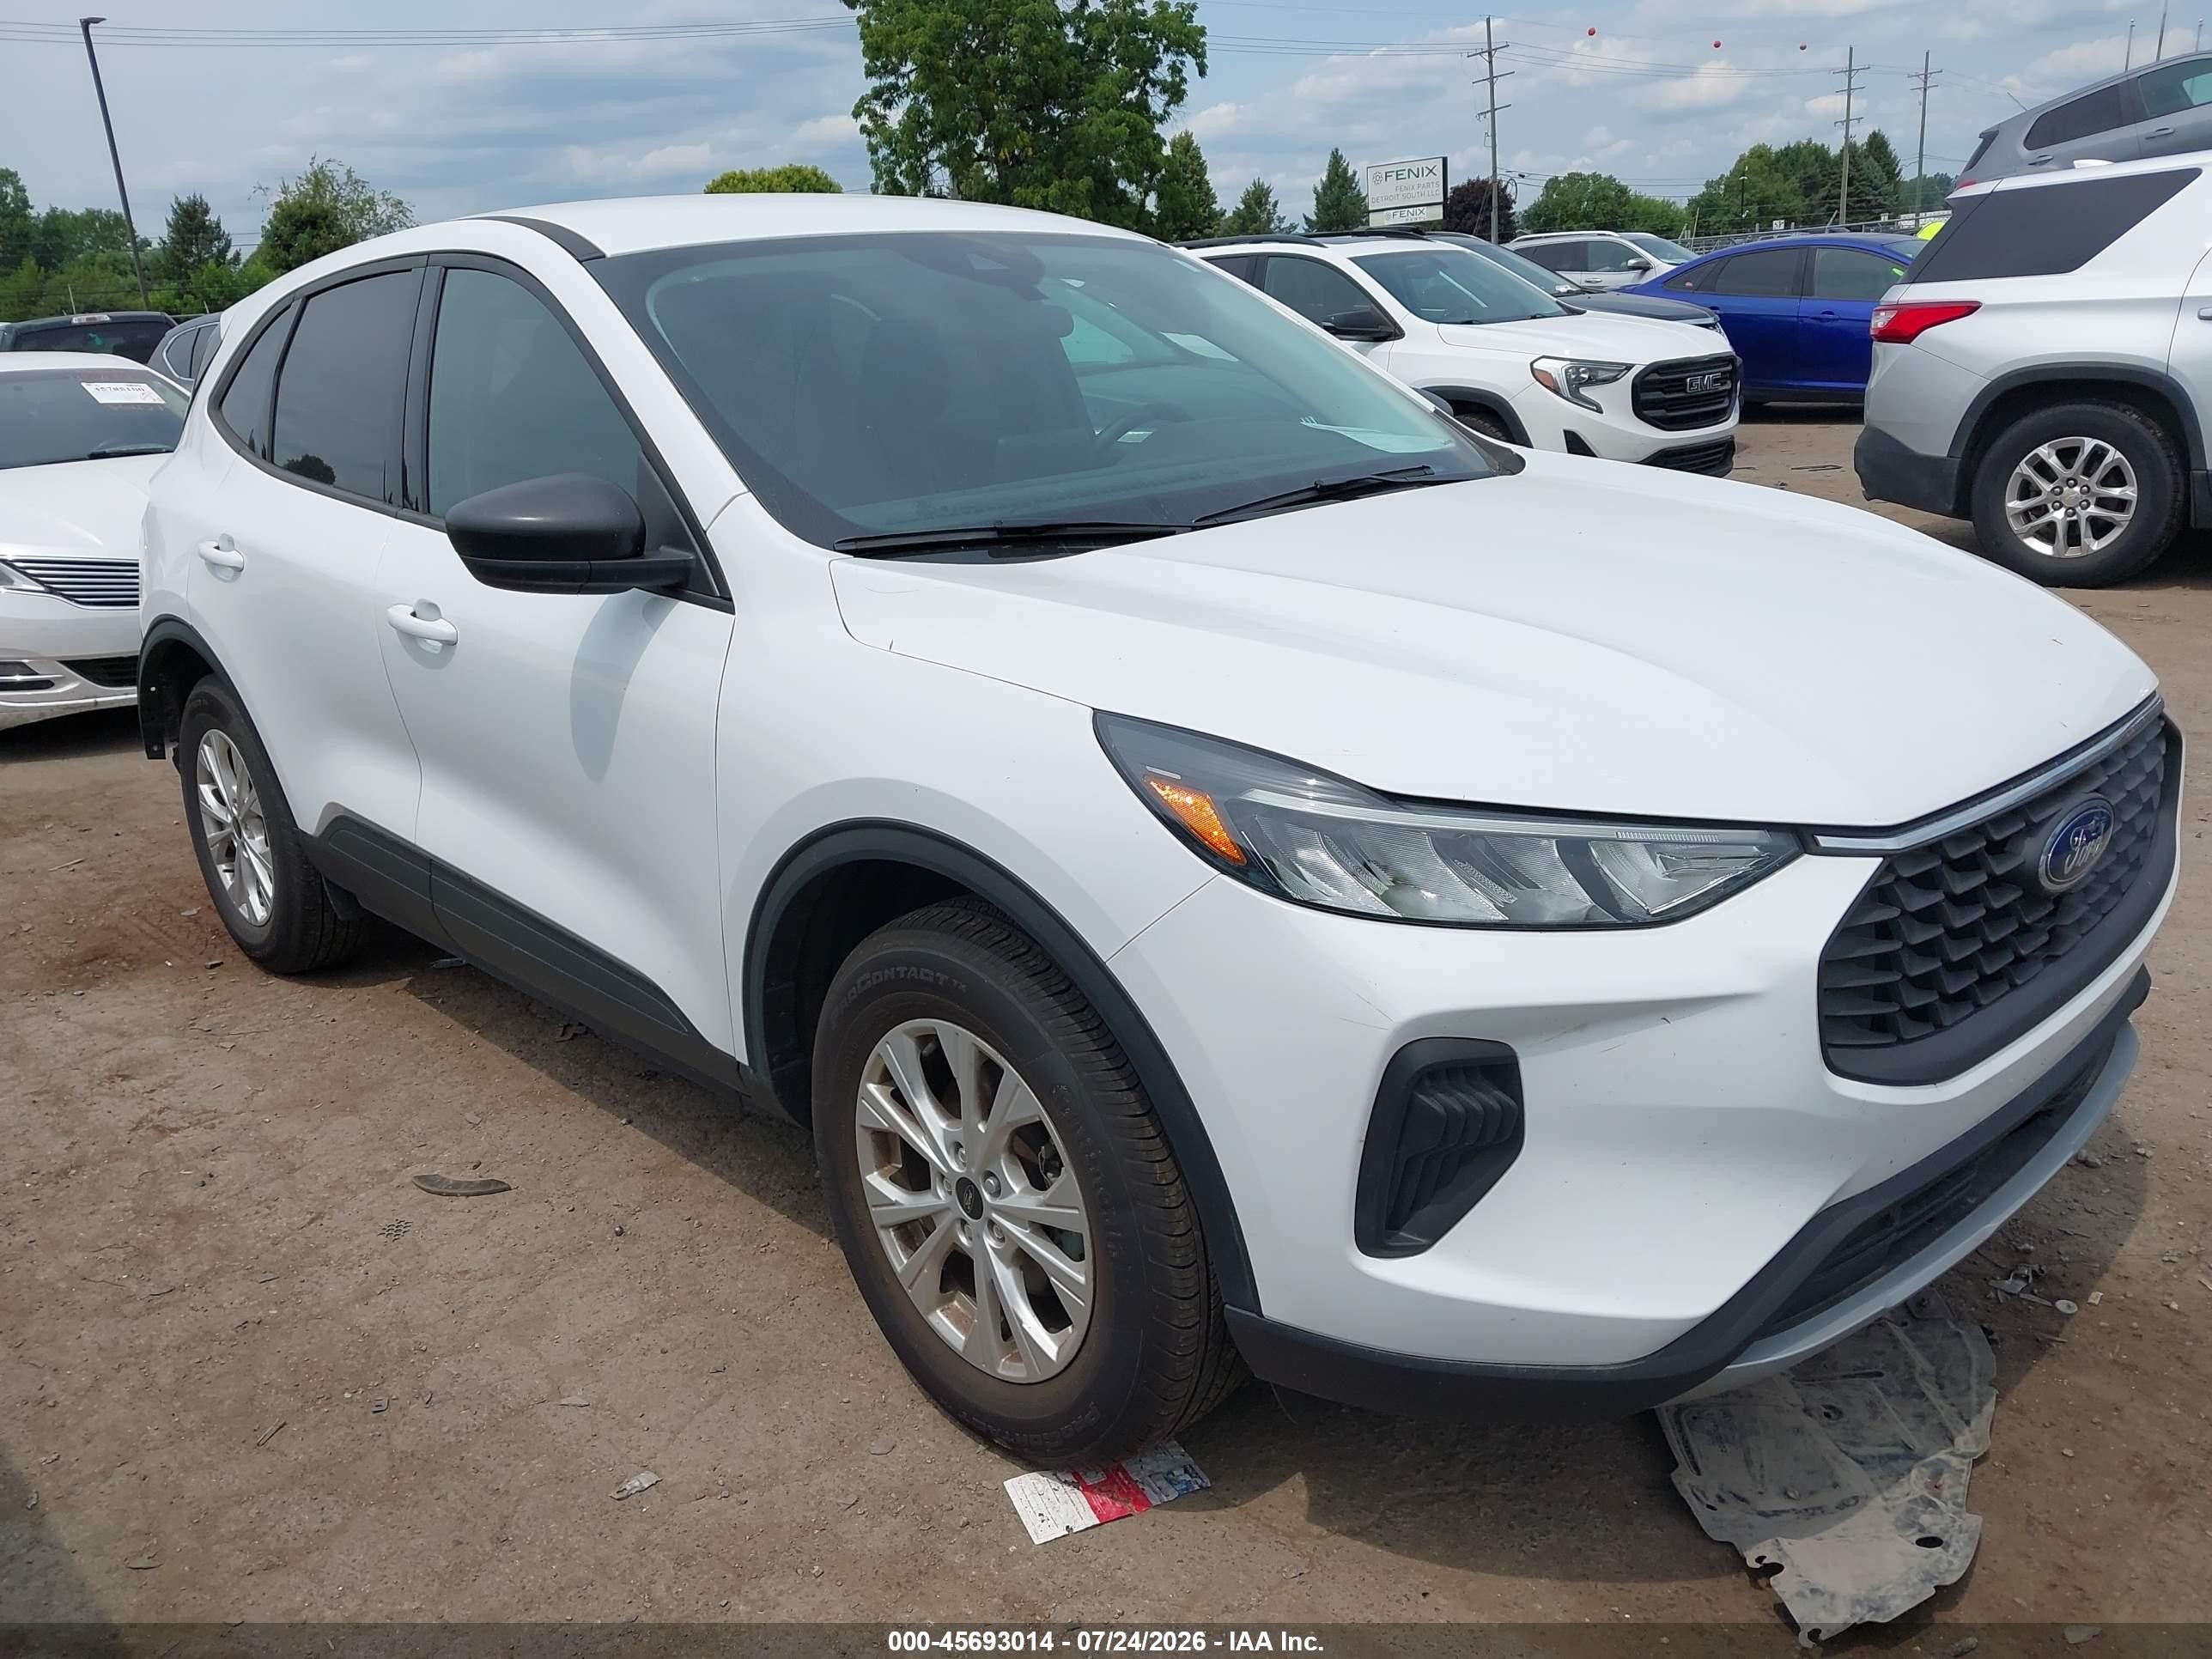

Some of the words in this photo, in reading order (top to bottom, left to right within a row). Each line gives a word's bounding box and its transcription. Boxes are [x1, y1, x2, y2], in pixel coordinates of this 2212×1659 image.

[1384, 164, 1437, 182] FENIX
[1417, 181, 1440, 190] PARTS
[1371, 193, 1400, 204] DETROIT
[1401, 191, 1425, 200] SOUTH
[1427, 189, 1441, 198] LLC
[1392, 208, 1425, 219] FENIX
[1686, 373, 1723, 393] GMC
[2064, 817, 2106, 875] Ford
